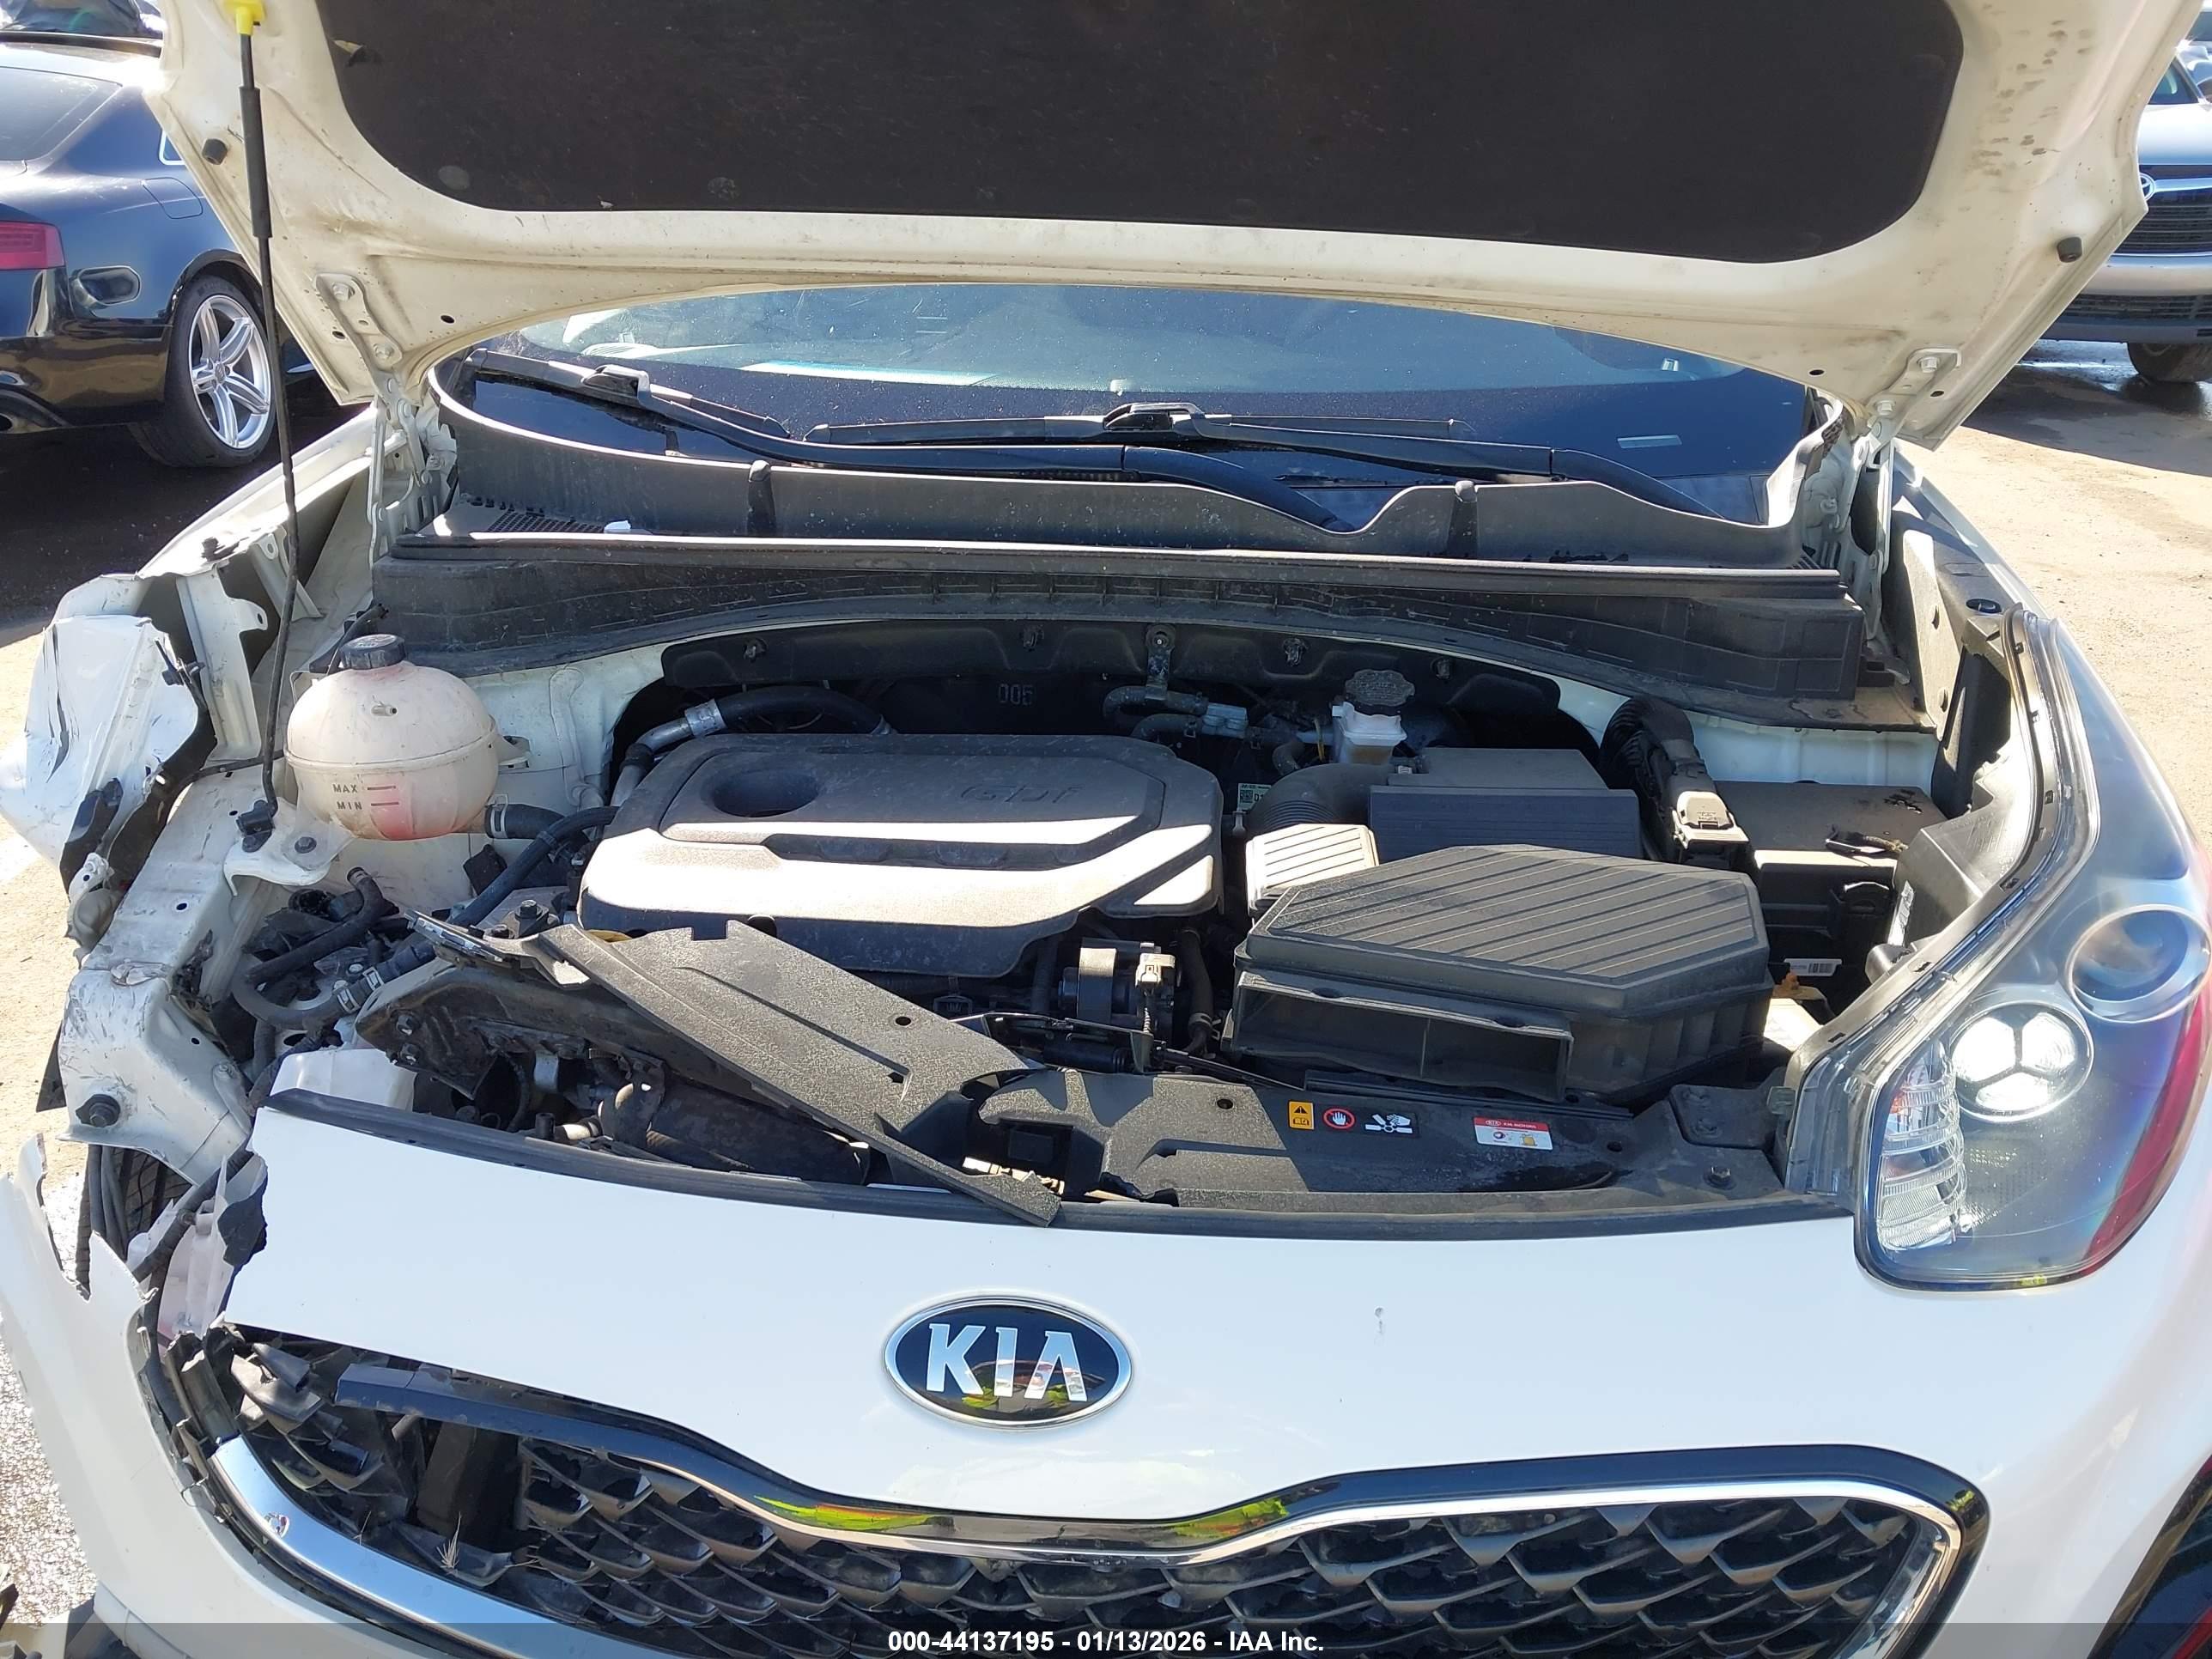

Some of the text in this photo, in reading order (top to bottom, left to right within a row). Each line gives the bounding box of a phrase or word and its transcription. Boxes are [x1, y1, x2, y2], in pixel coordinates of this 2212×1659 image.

[332, 784, 358, 793] MAX
[337, 801, 362, 810] MIN
[927, 1323, 1087, 1401] KIA
